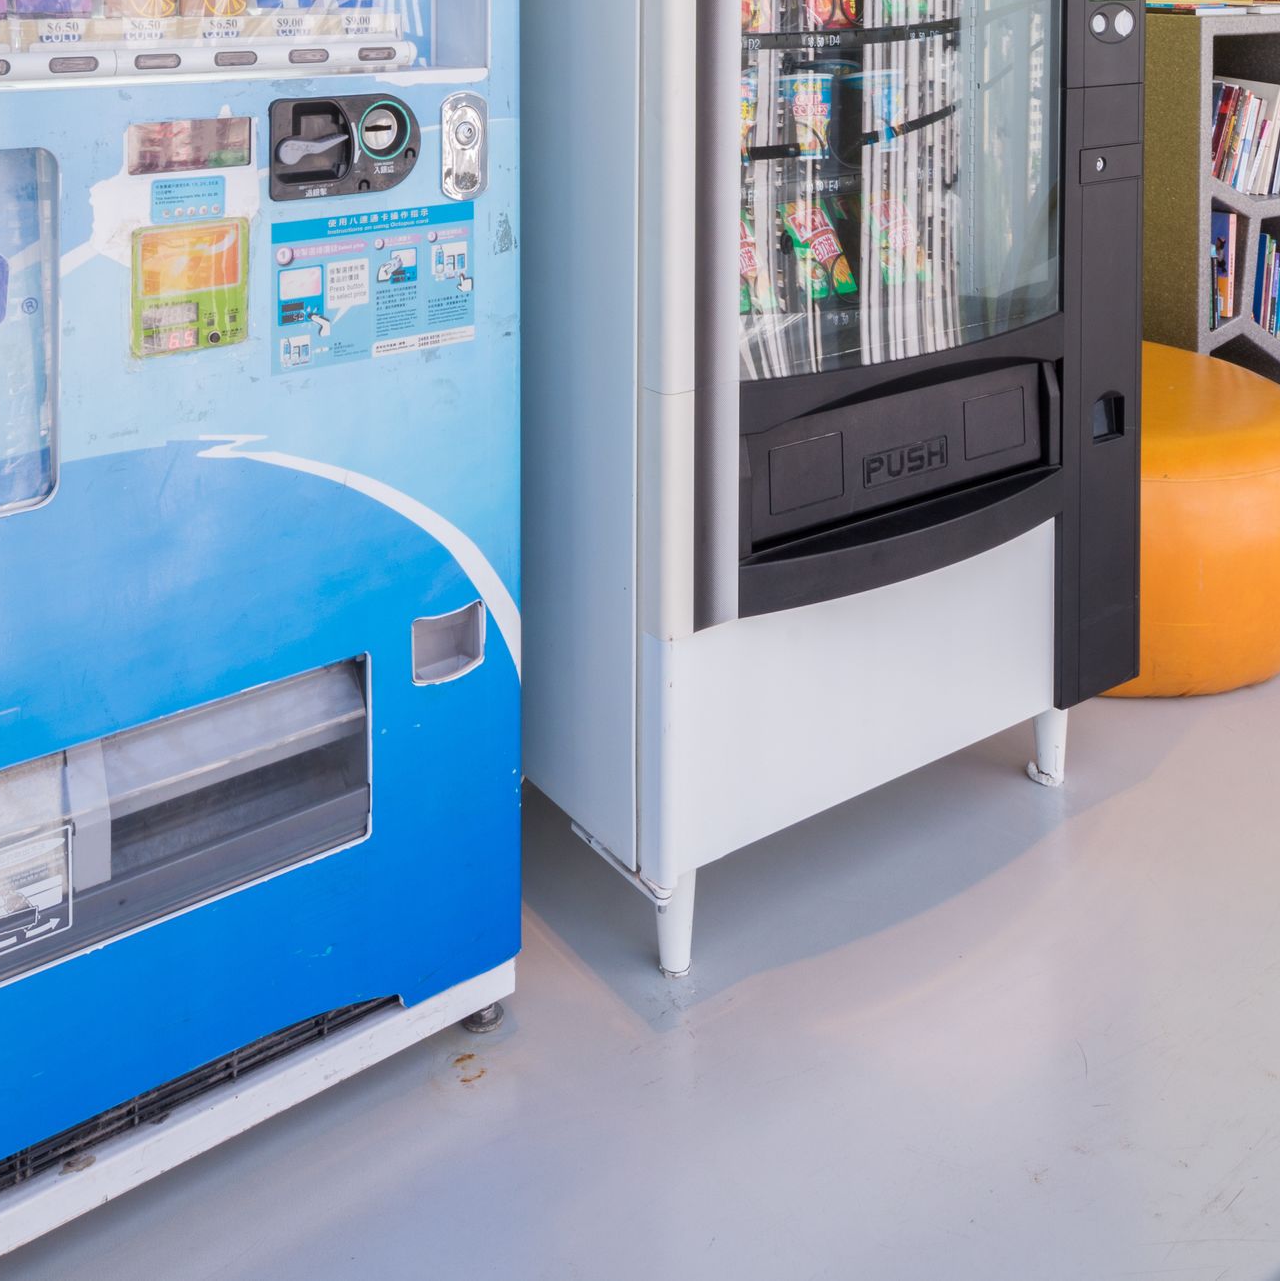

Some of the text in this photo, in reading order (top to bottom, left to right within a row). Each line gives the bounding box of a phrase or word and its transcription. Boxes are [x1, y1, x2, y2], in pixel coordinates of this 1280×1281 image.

[130, 20, 161, 30] $6.50
[208, 19, 238, 30] $6.50
[276, 17, 303, 28] $9.00
[344, 15, 371, 26] $9.00
[46, 21, 80, 33] $6.50
[748, 38, 760, 50] D2
[829, 35, 840, 46] D4
[829, 181, 839, 192] E4
[328, 226, 363, 235] Instructions
[390, 220, 415, 228] Octopus
[329, 282, 364, 293] Press button
[336, 291, 353, 300] select
[353, 290, 367, 300] price
[865, 444, 946, 484] PUSH
